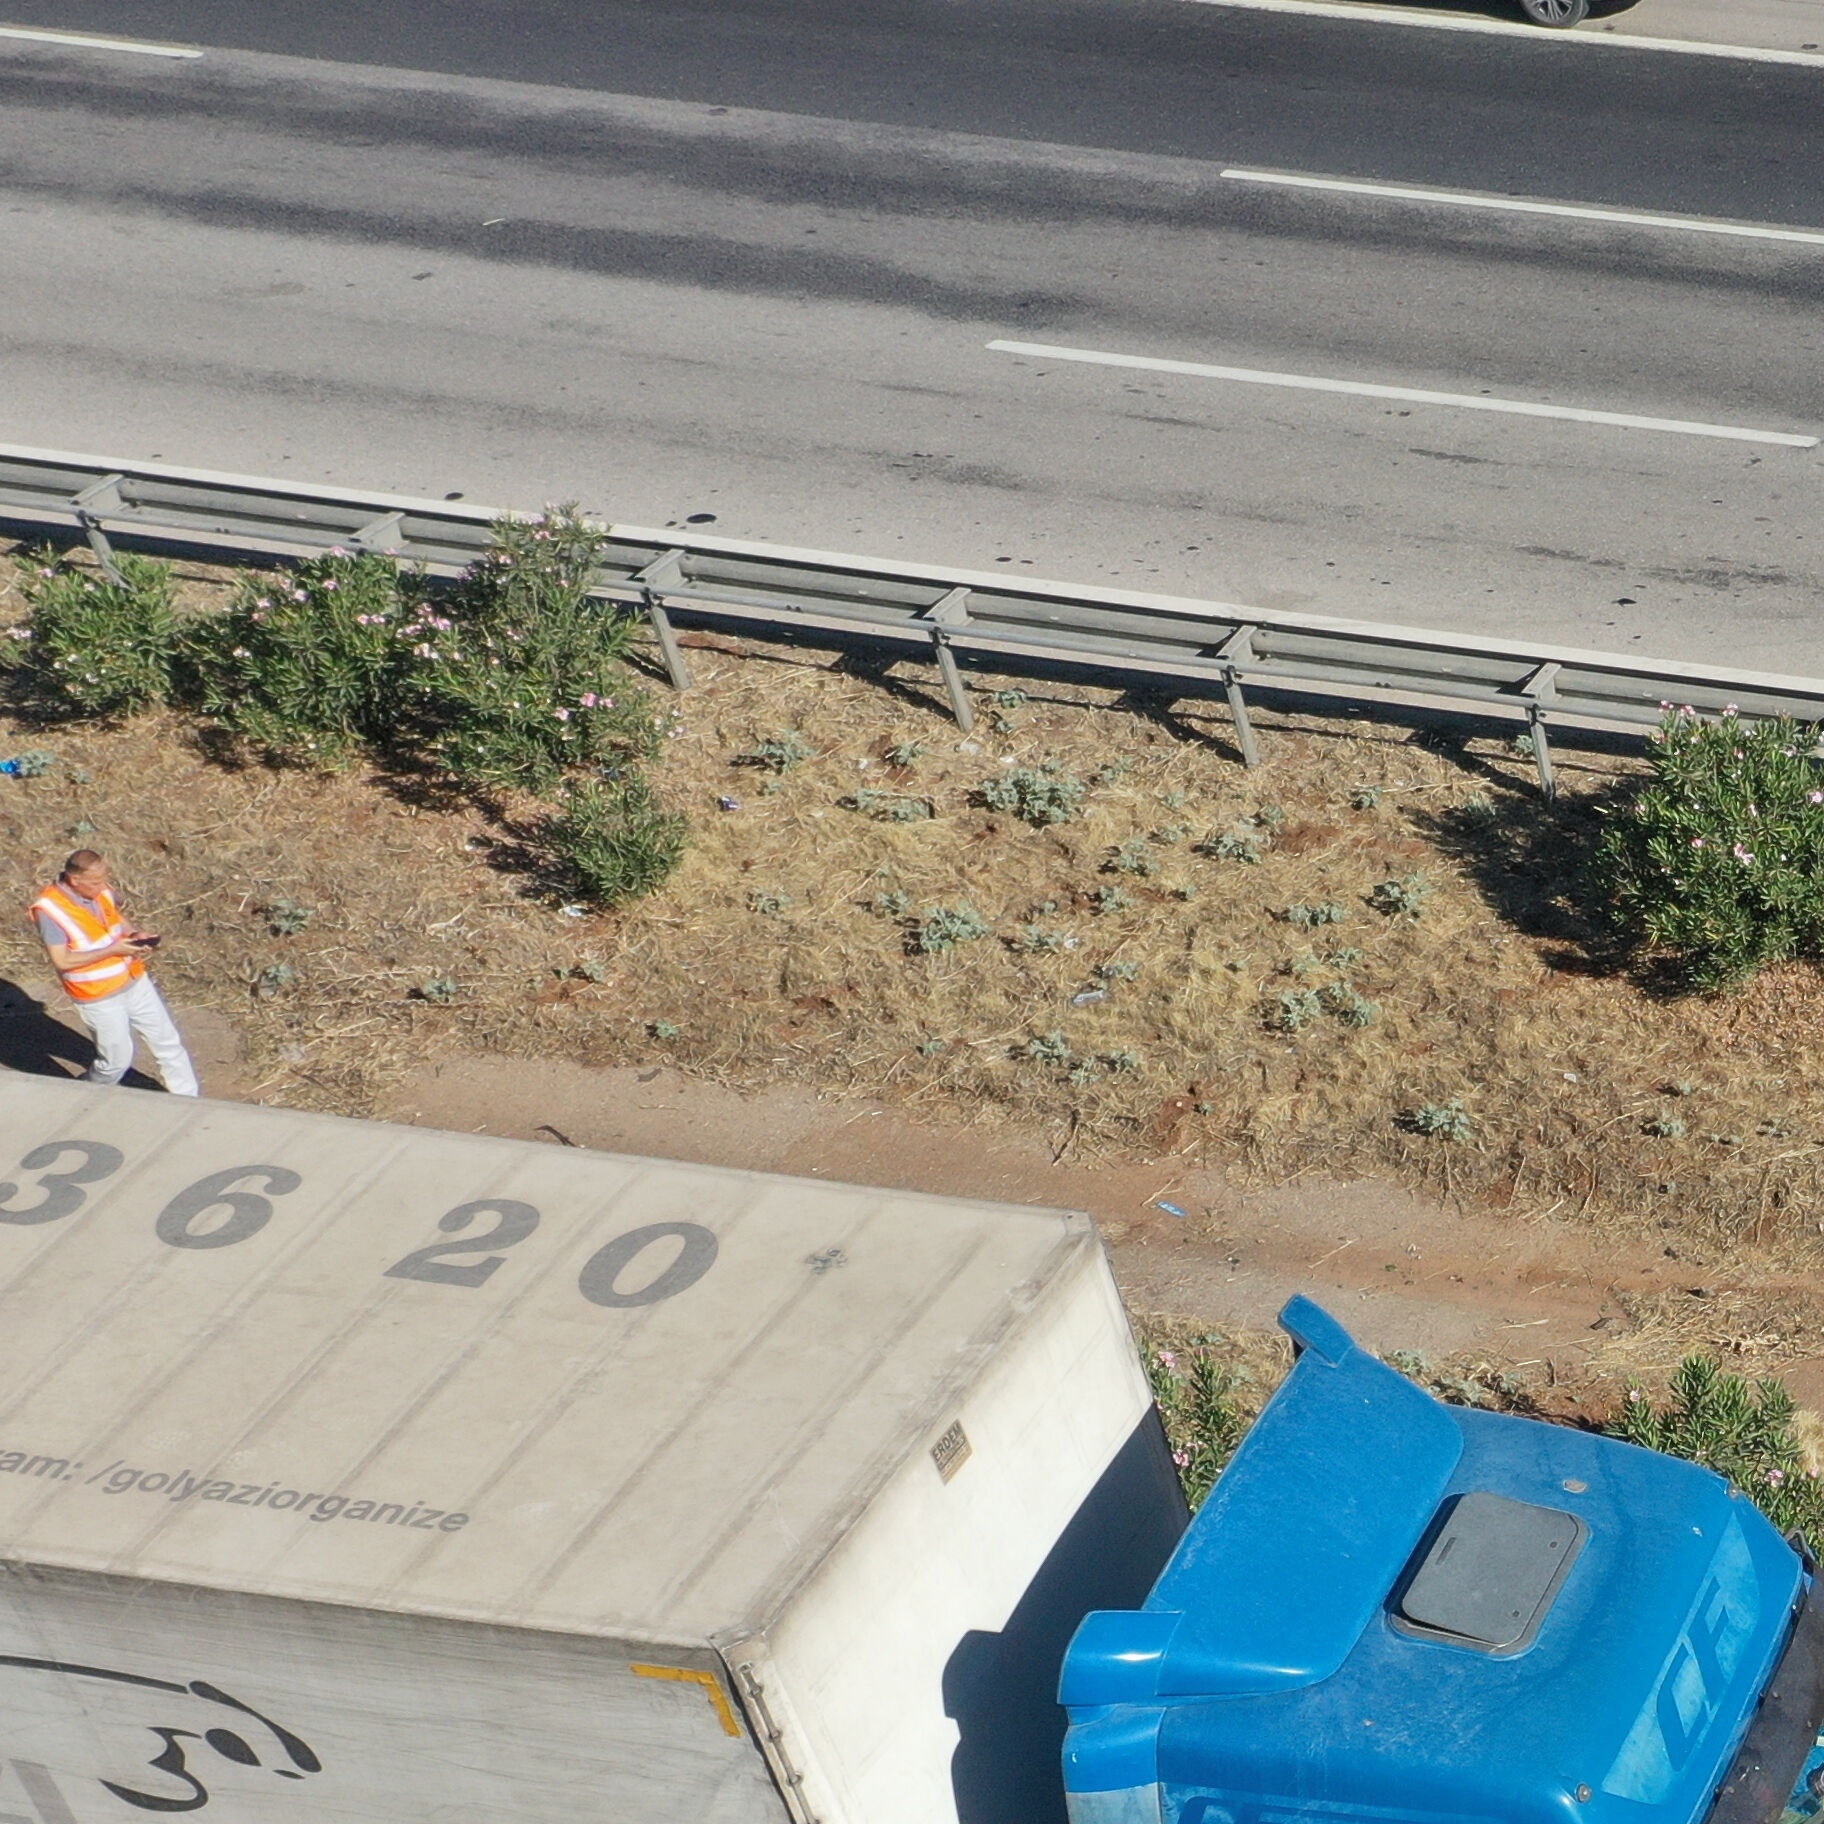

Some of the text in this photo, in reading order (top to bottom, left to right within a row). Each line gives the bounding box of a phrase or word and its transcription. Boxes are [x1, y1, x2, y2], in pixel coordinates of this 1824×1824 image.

[382, 1198, 719, 1309] 20
[0, 1448, 470, 1533] am: /golyaziorganize
